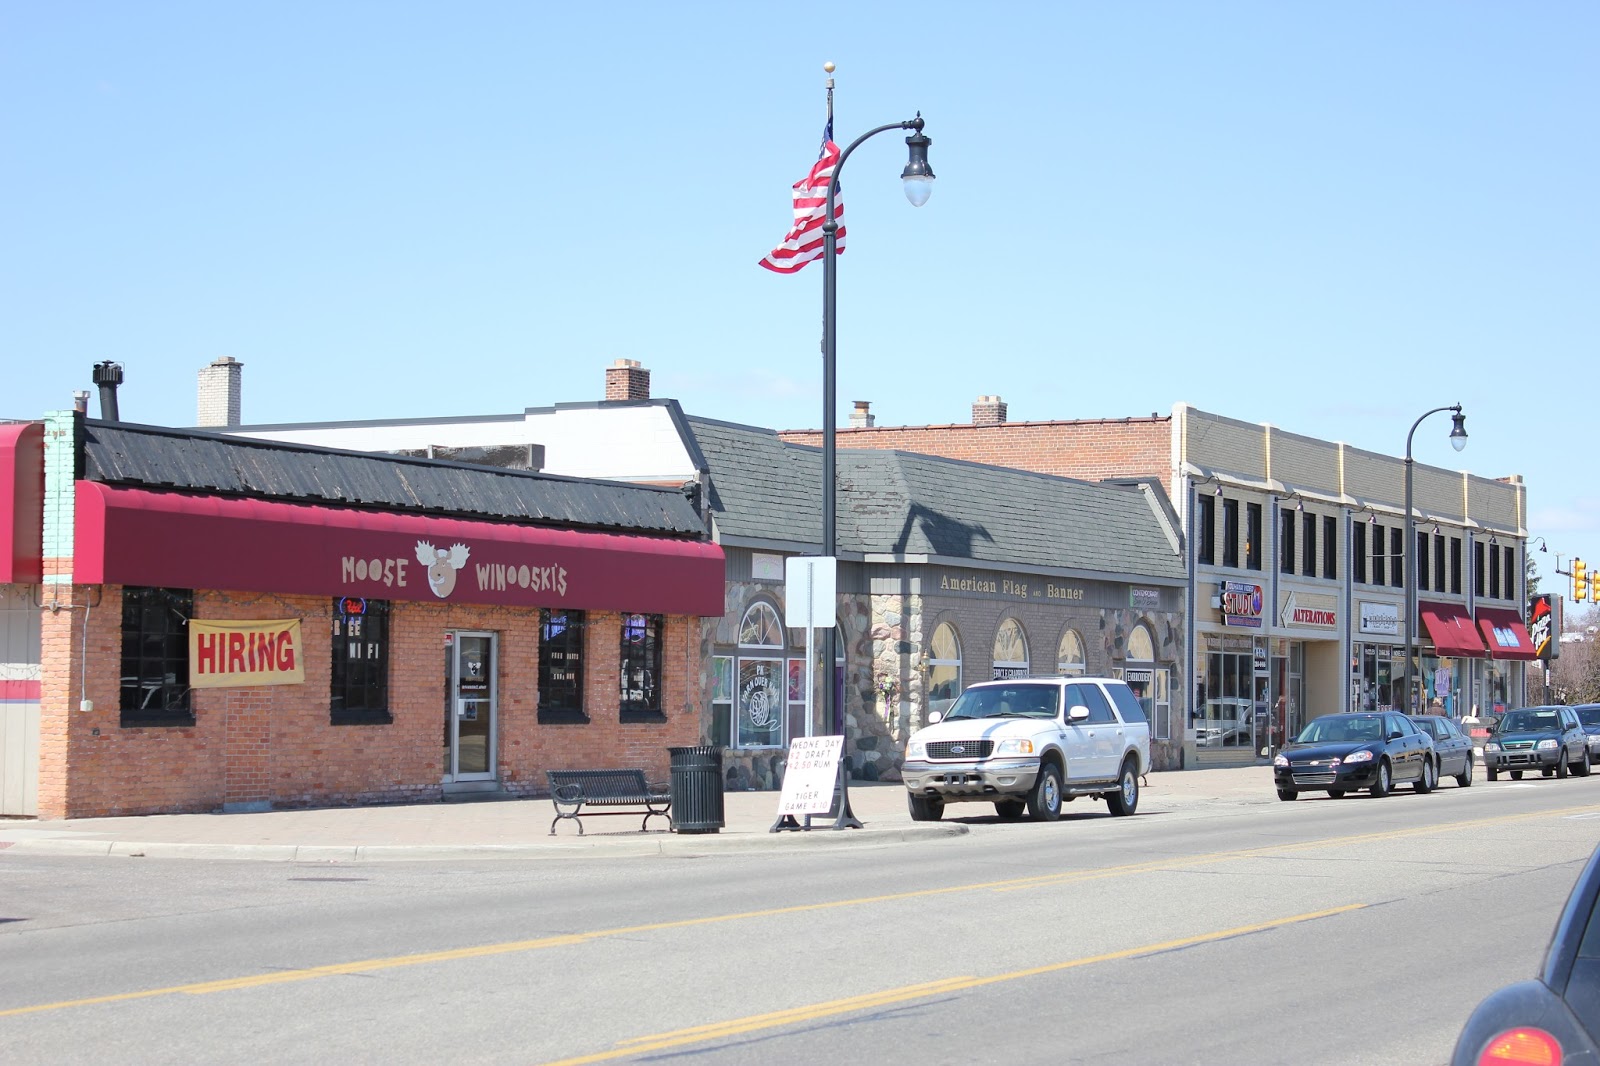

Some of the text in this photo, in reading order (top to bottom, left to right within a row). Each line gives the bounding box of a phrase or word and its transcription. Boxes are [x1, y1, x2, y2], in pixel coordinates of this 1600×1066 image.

[342, 556, 568, 597] MOOSE WINOOSKI'S
[940, 574, 997, 593] American
[1002, 580, 1028, 599] Flag
[1046, 583, 1084, 600] Banner
[1293, 608, 1336, 625] ALTERATIONS
[197, 630, 295, 674] HIRING
[993, 668, 1008, 678] EHICLE
[754, 676, 769, 688] OVER
[804, 749, 831, 759] DRAFT
[813, 760, 831, 769] RUM
[795, 790, 820, 800] TIGER
[784, 802, 808, 811] GAME
